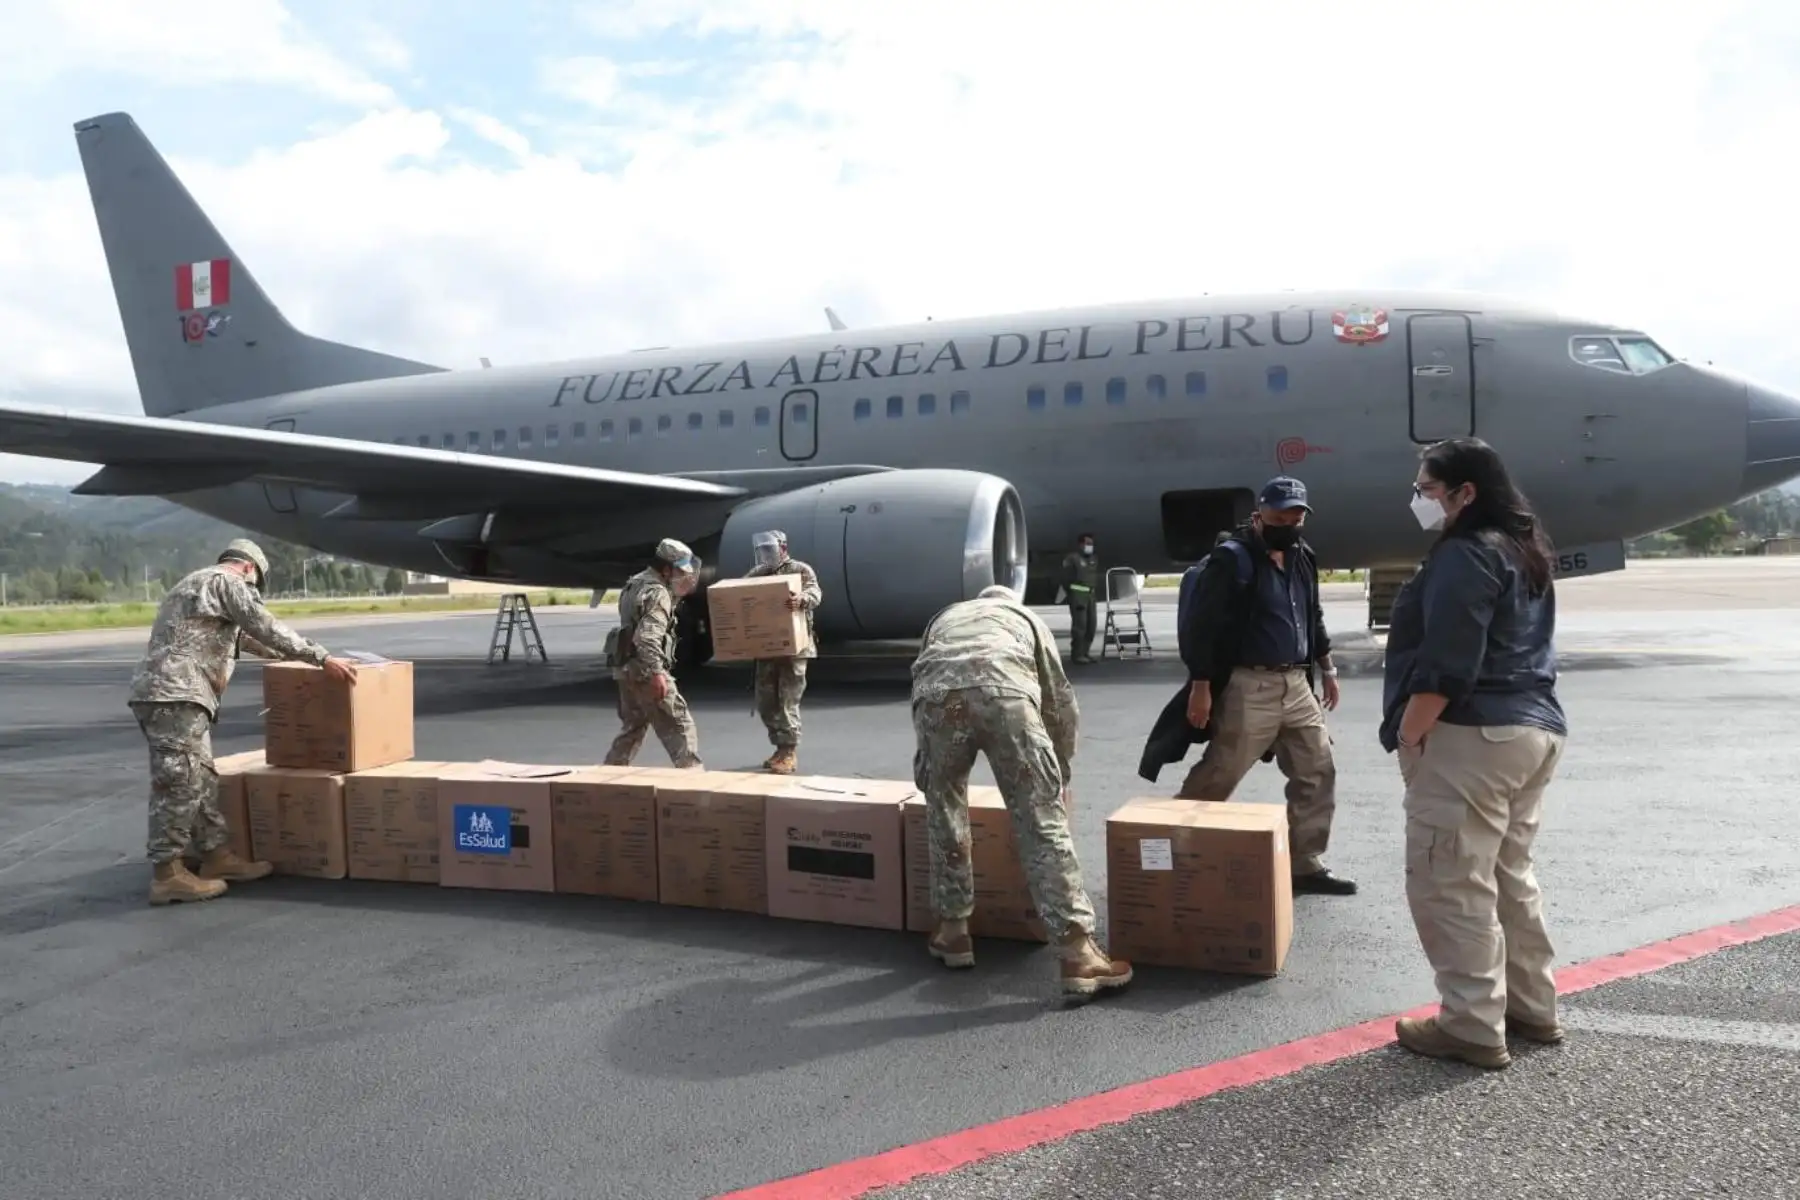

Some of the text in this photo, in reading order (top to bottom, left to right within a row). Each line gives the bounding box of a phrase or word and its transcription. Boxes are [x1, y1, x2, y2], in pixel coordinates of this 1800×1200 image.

[549, 304, 1314, 407] FUERZA AÉREA DEL PERÚ
[459, 832, 506, 848] EsSalud
